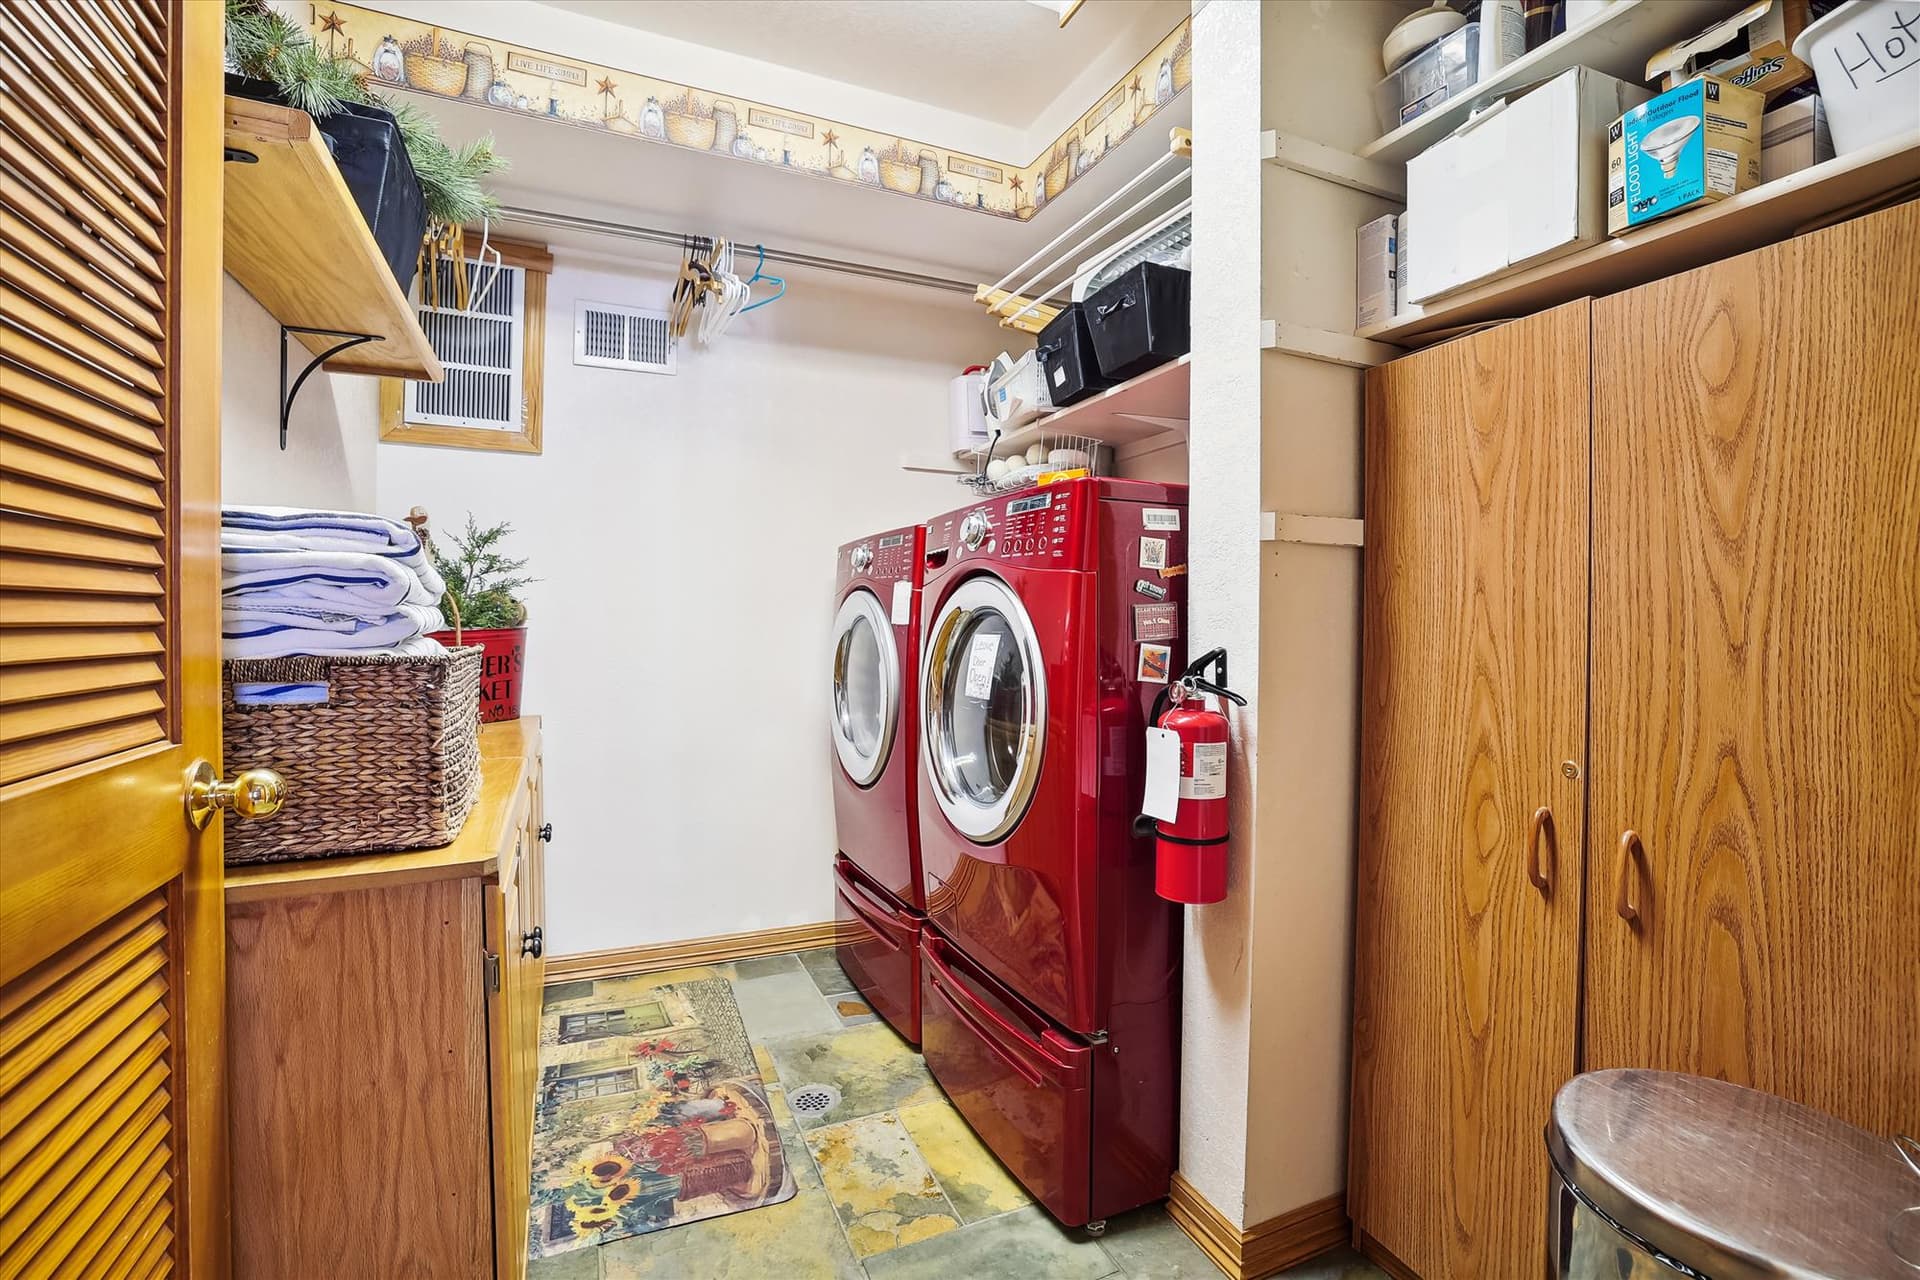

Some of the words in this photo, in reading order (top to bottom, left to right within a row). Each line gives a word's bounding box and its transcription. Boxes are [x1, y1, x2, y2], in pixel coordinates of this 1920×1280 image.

[1833, 9, 1920, 90] Hot
[1678, 89, 1700, 103] Flood
[1627, 130, 1640, 161] LIGHT
[1611, 157, 1622, 169] 60
[1629, 165, 1641, 204] FLOOD
